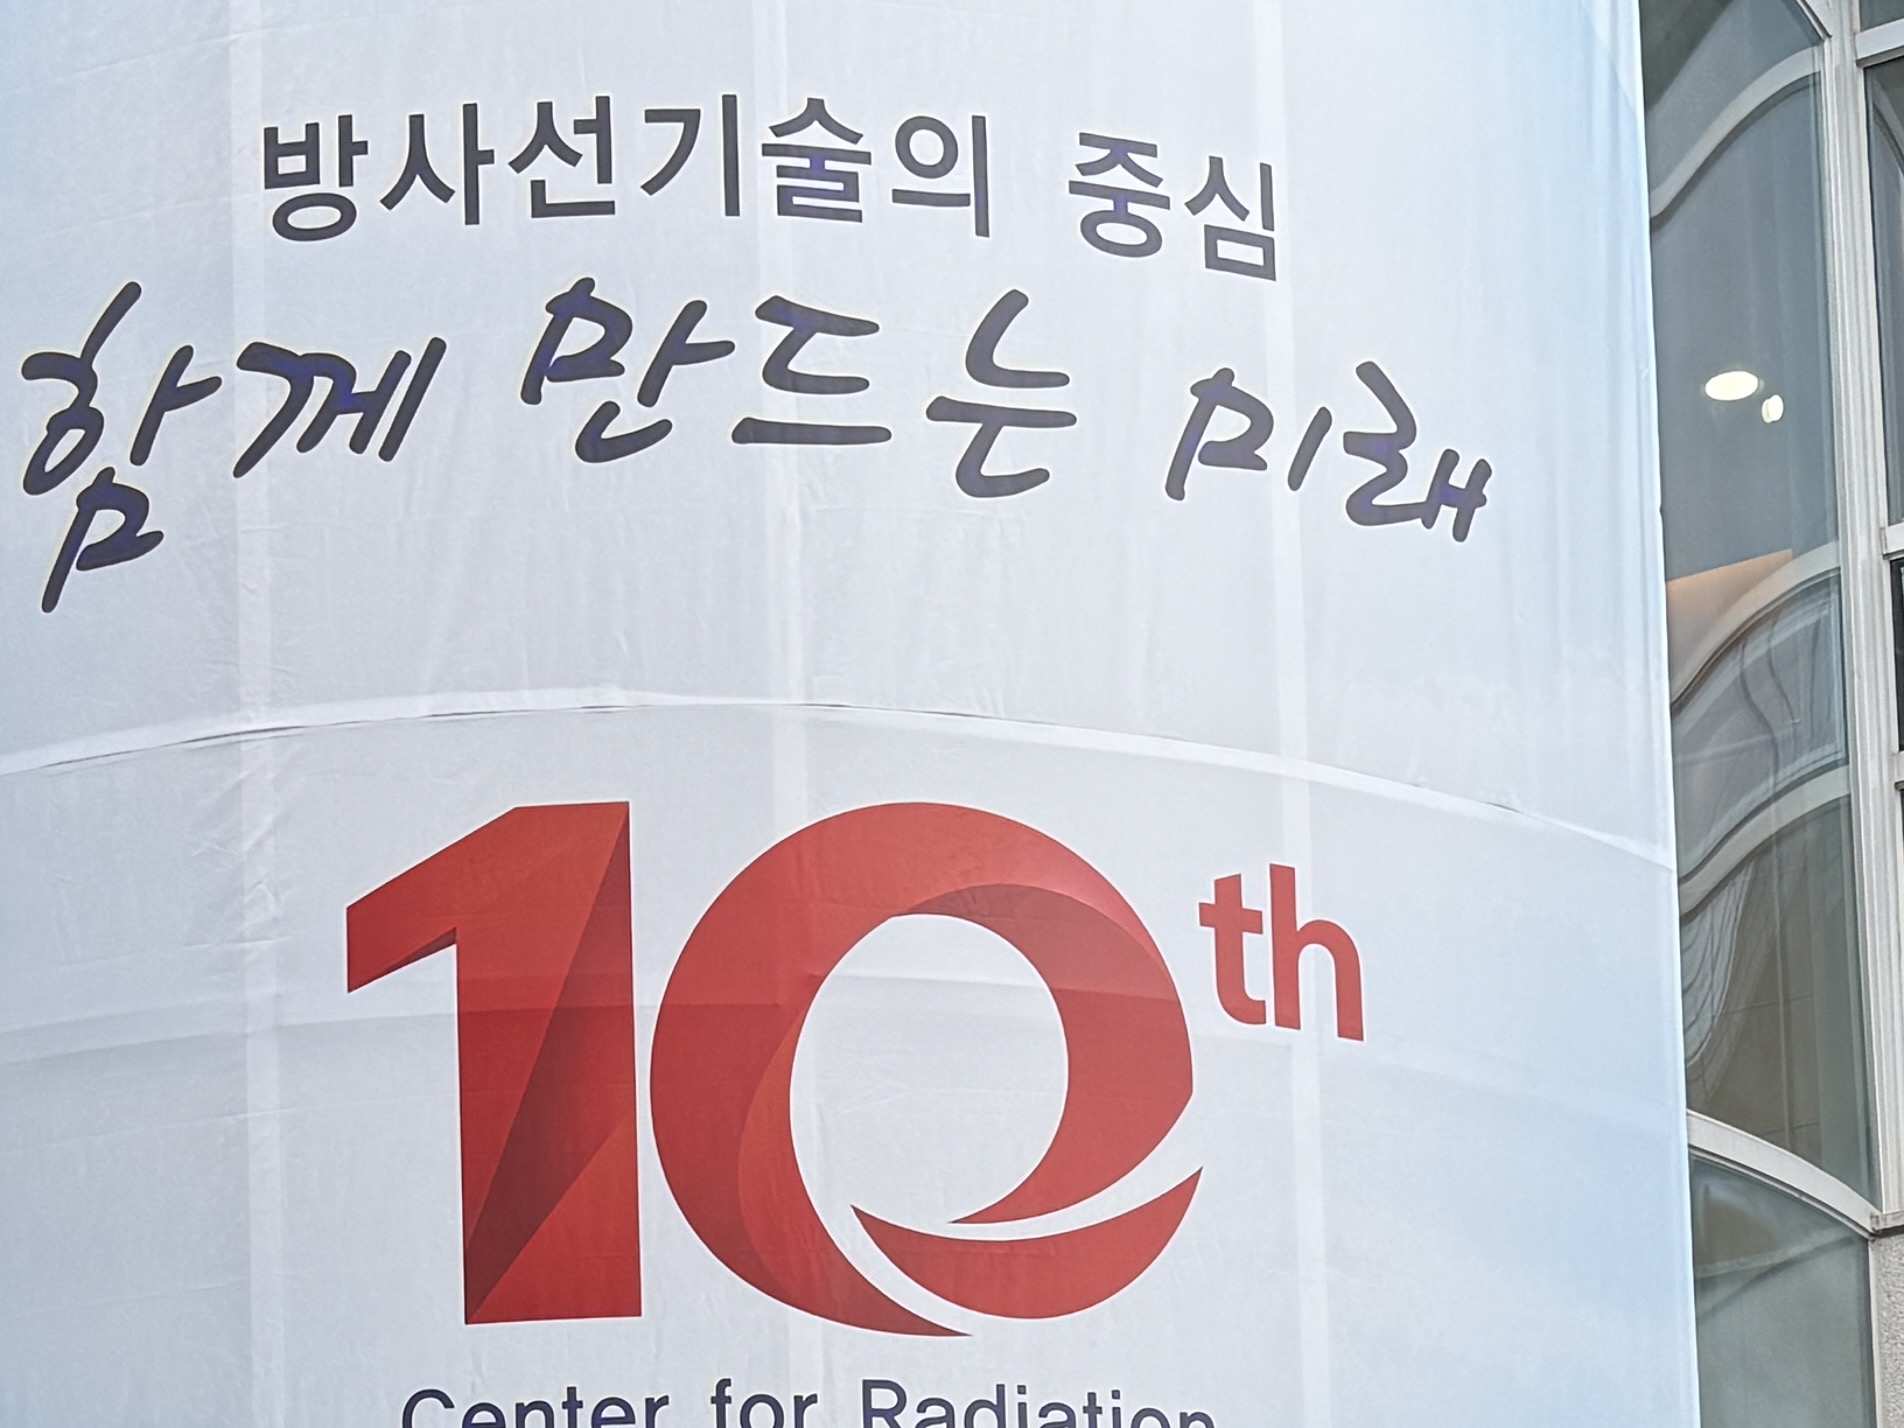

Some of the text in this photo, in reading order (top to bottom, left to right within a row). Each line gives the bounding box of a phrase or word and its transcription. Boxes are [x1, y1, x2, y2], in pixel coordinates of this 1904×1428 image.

[262, 93, 1277, 282] 방사선기술의 중심
[20, 276, 1493, 615] 함께 만드는 미래
